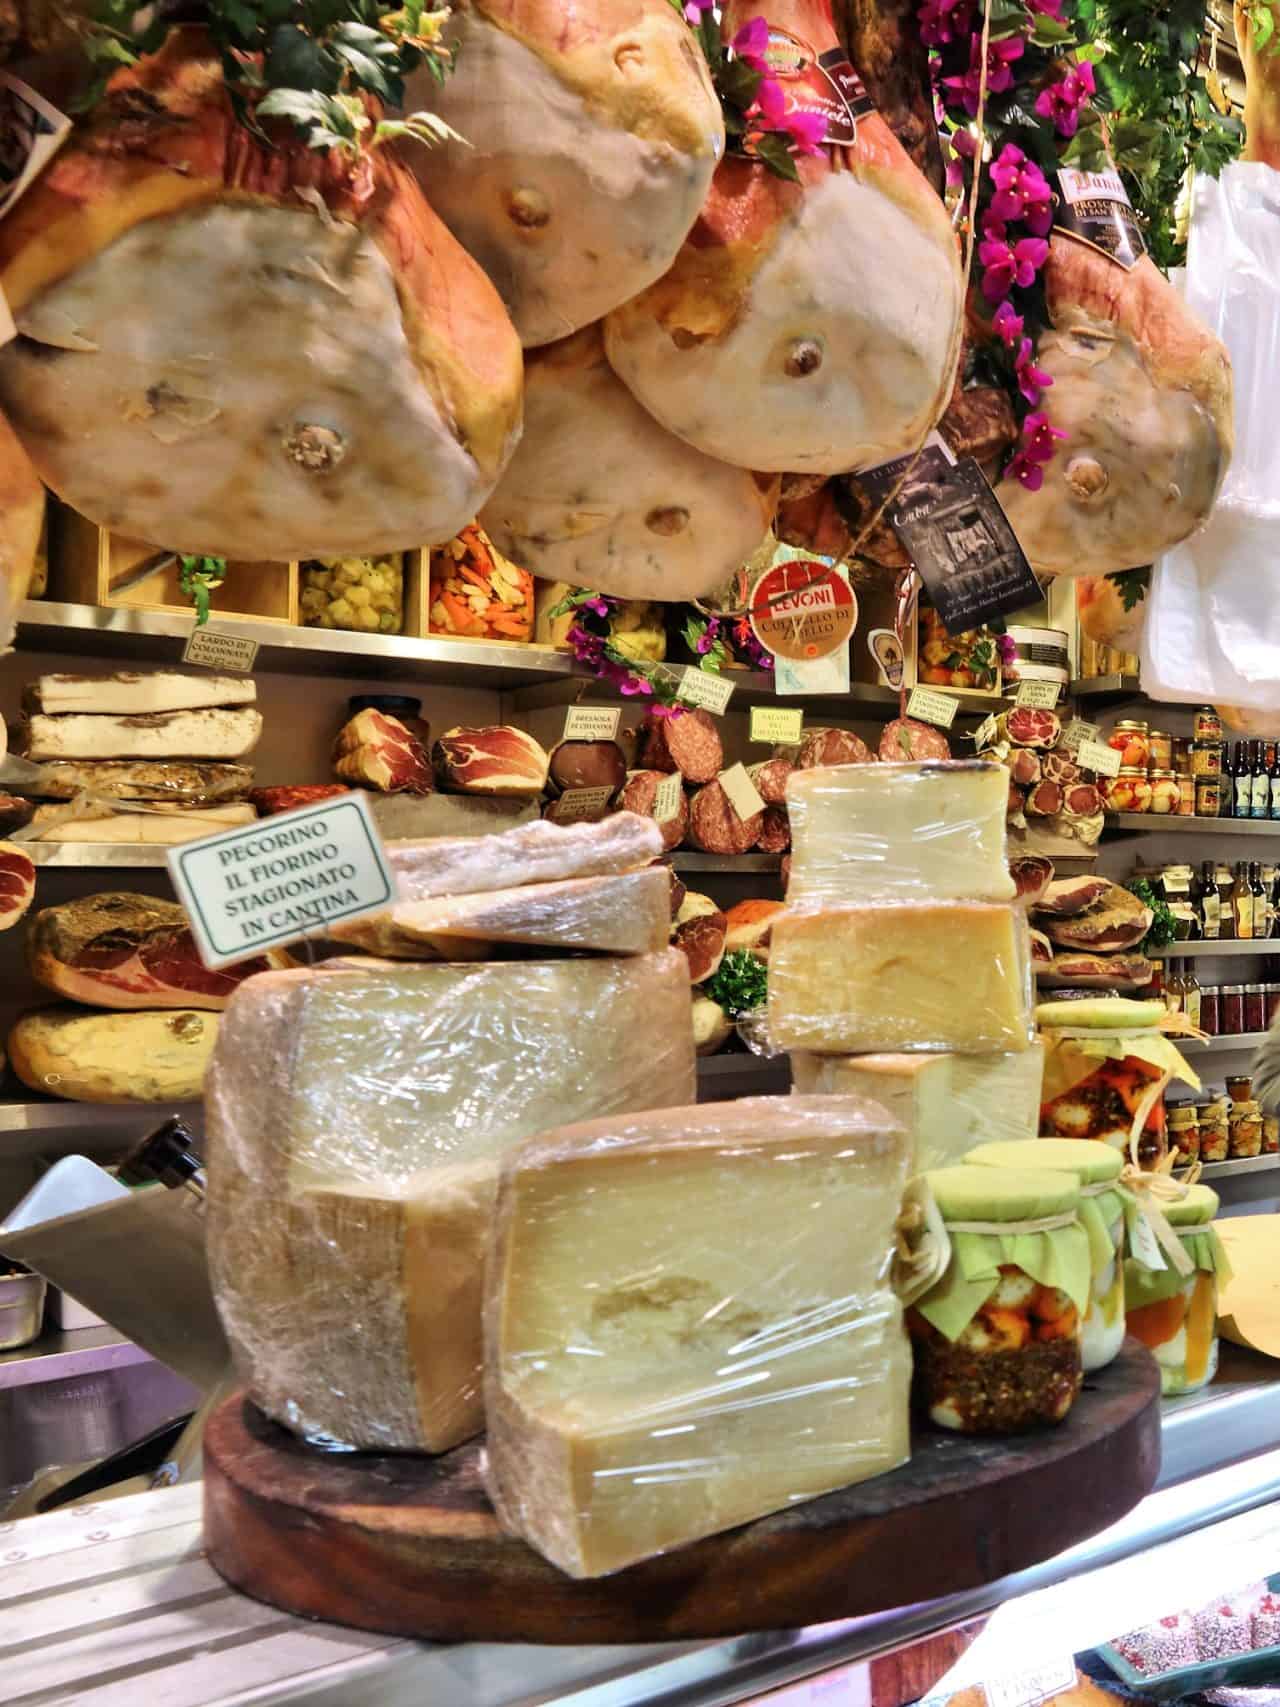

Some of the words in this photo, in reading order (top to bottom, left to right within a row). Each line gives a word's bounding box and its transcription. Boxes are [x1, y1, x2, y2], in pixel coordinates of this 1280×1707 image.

[774, 590, 832, 612] LEVONI
[217, 820, 330, 867] PECORINO
[224, 871, 248, 892] IL
[249, 842, 340, 884] FIORINO
[224, 863, 357, 918] STAGIONATO
[240, 917, 265, 939] IN
[269, 887, 361, 930] CANTINA
